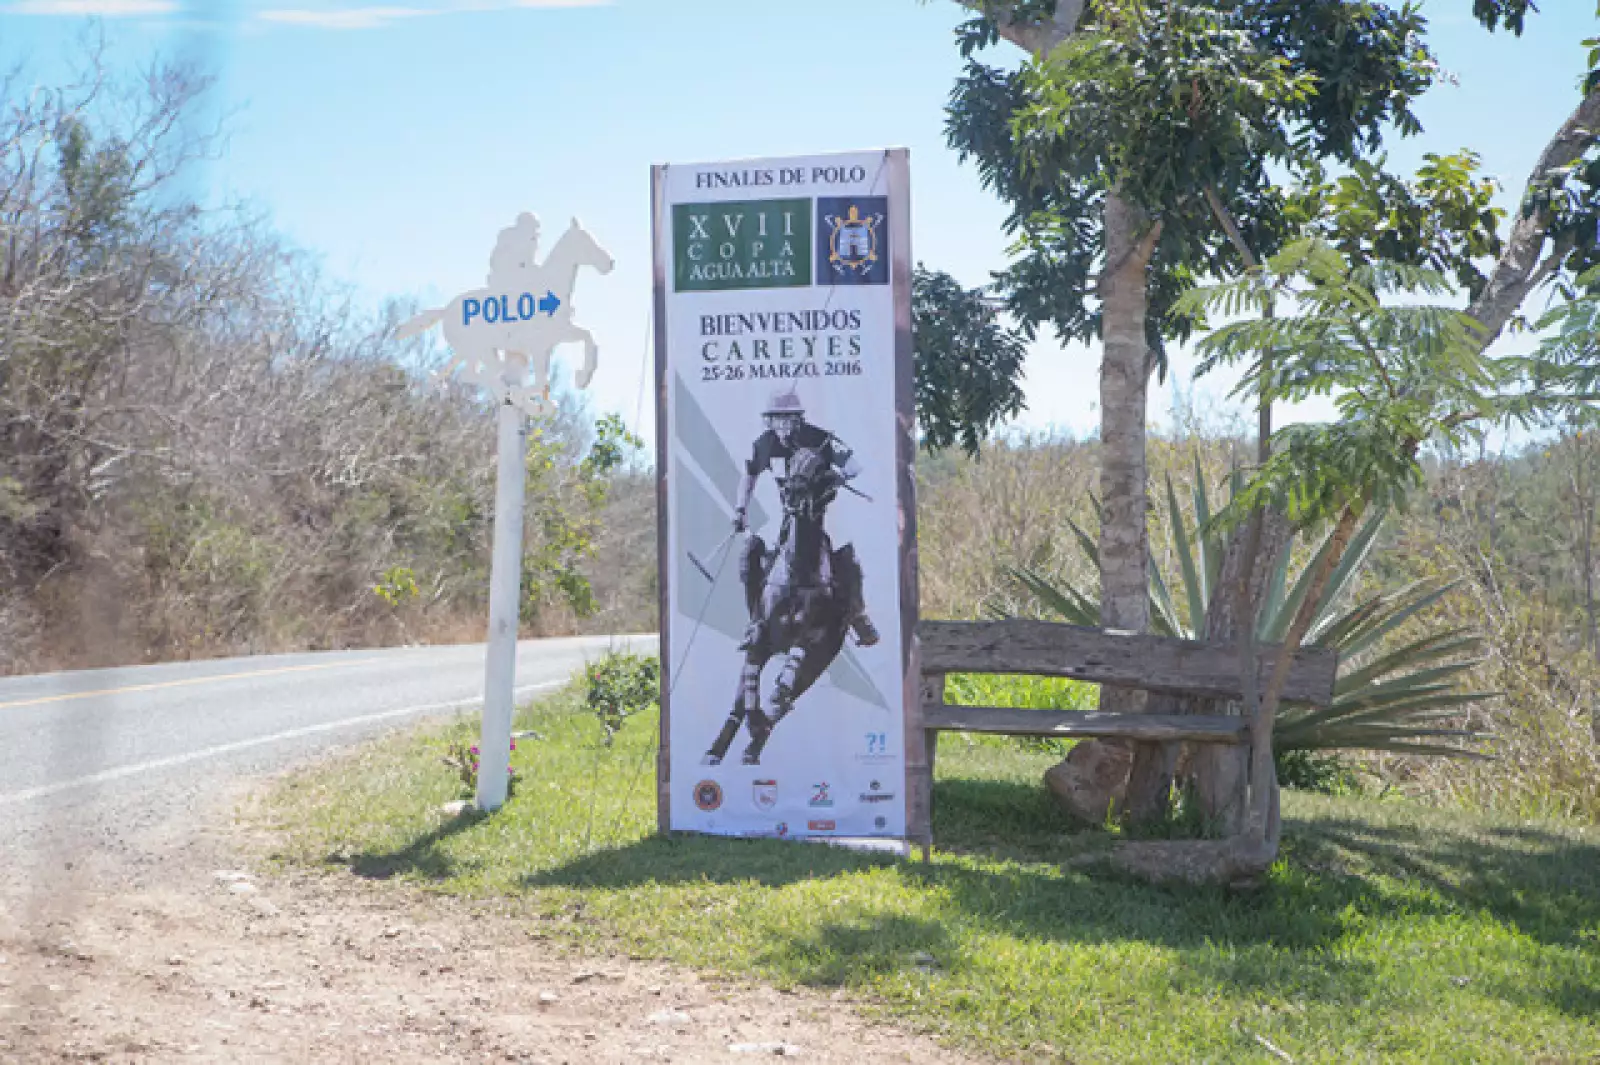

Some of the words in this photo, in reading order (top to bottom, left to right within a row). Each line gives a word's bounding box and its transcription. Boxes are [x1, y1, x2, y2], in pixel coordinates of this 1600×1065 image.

[696, 170, 773, 188] FINALES
[780, 167, 804, 183] DE
[812, 165, 865, 183] POLO
[690, 263, 744, 280] AGUA
[747, 259, 795, 278] ALTA
[463, 292, 535, 325] POLO
[700, 310, 860, 335] BIENVENIDOS
[702, 335, 860, 362] CAREYES
[702, 364, 744, 380] 25-26
[824, 360, 861, 376] 2016
